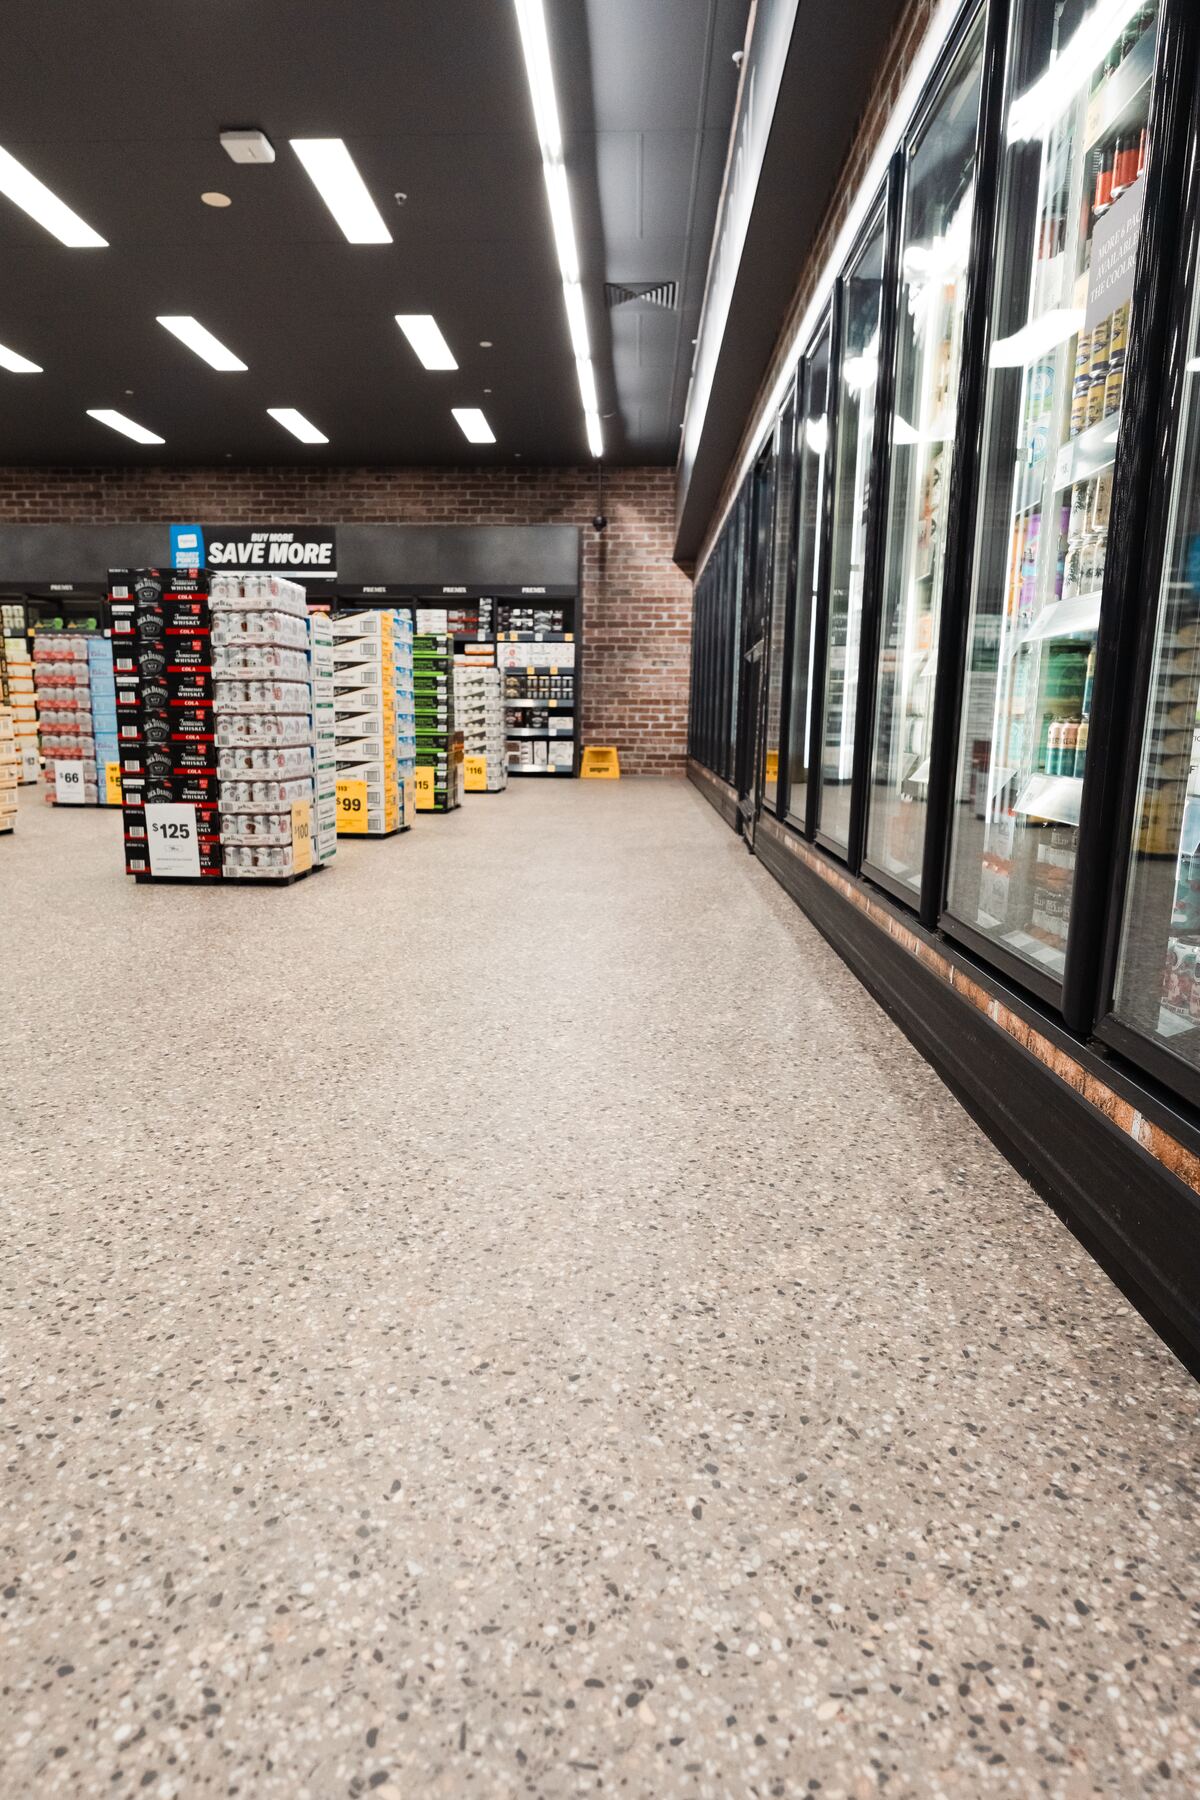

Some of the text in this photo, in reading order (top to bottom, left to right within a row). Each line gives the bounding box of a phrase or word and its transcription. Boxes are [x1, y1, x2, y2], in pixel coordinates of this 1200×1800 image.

[1126, 208, 1140, 233] PAC
[1090, 280, 1105, 303] THE
[251, 533, 294, 542] BUY MORE
[208, 542, 333, 564] SAVE MORE
[110, 776, 121, 787] $5
[336, 797, 361, 811] $99
[152, 822, 190, 839] $125
